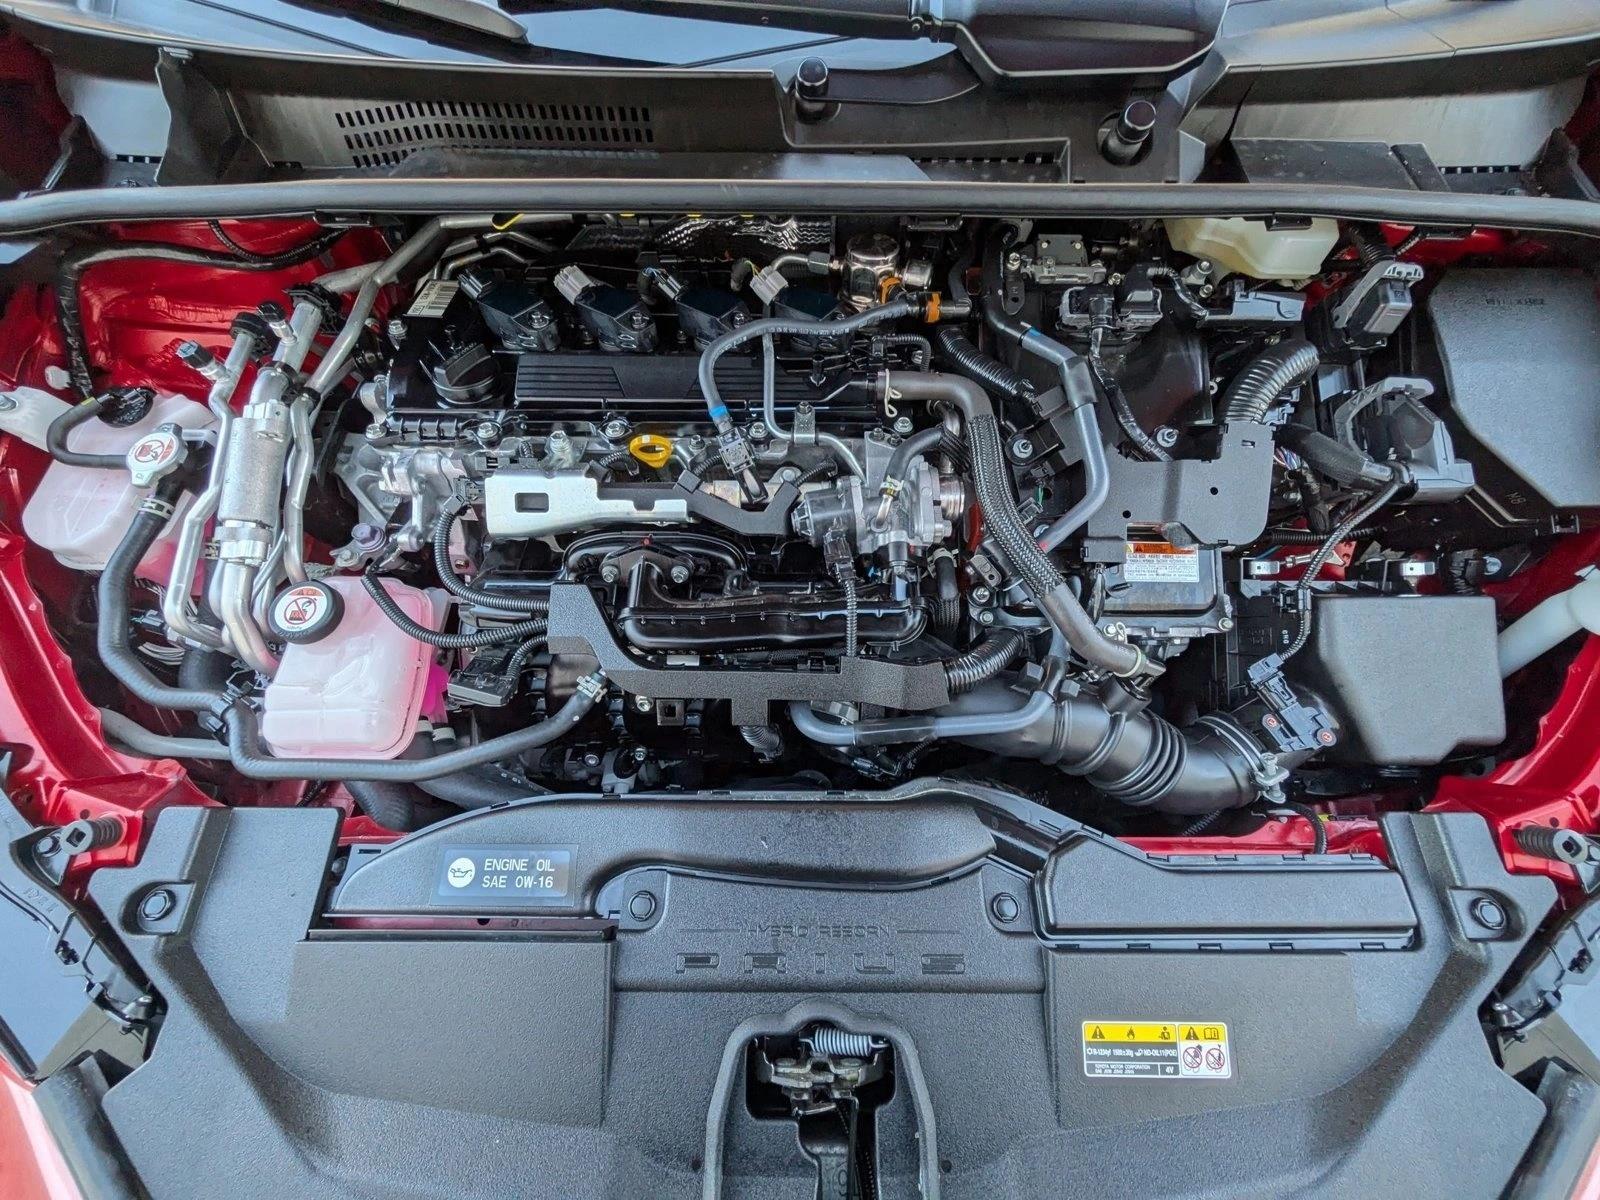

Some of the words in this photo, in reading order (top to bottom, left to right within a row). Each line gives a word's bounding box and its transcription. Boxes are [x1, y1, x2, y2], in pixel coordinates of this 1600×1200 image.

[484, 858, 528, 871] ENGINE
[536, 859, 555, 872] OIL
[482, 875, 507, 888] SAE
[675, 951, 966, 975] PRIUS
